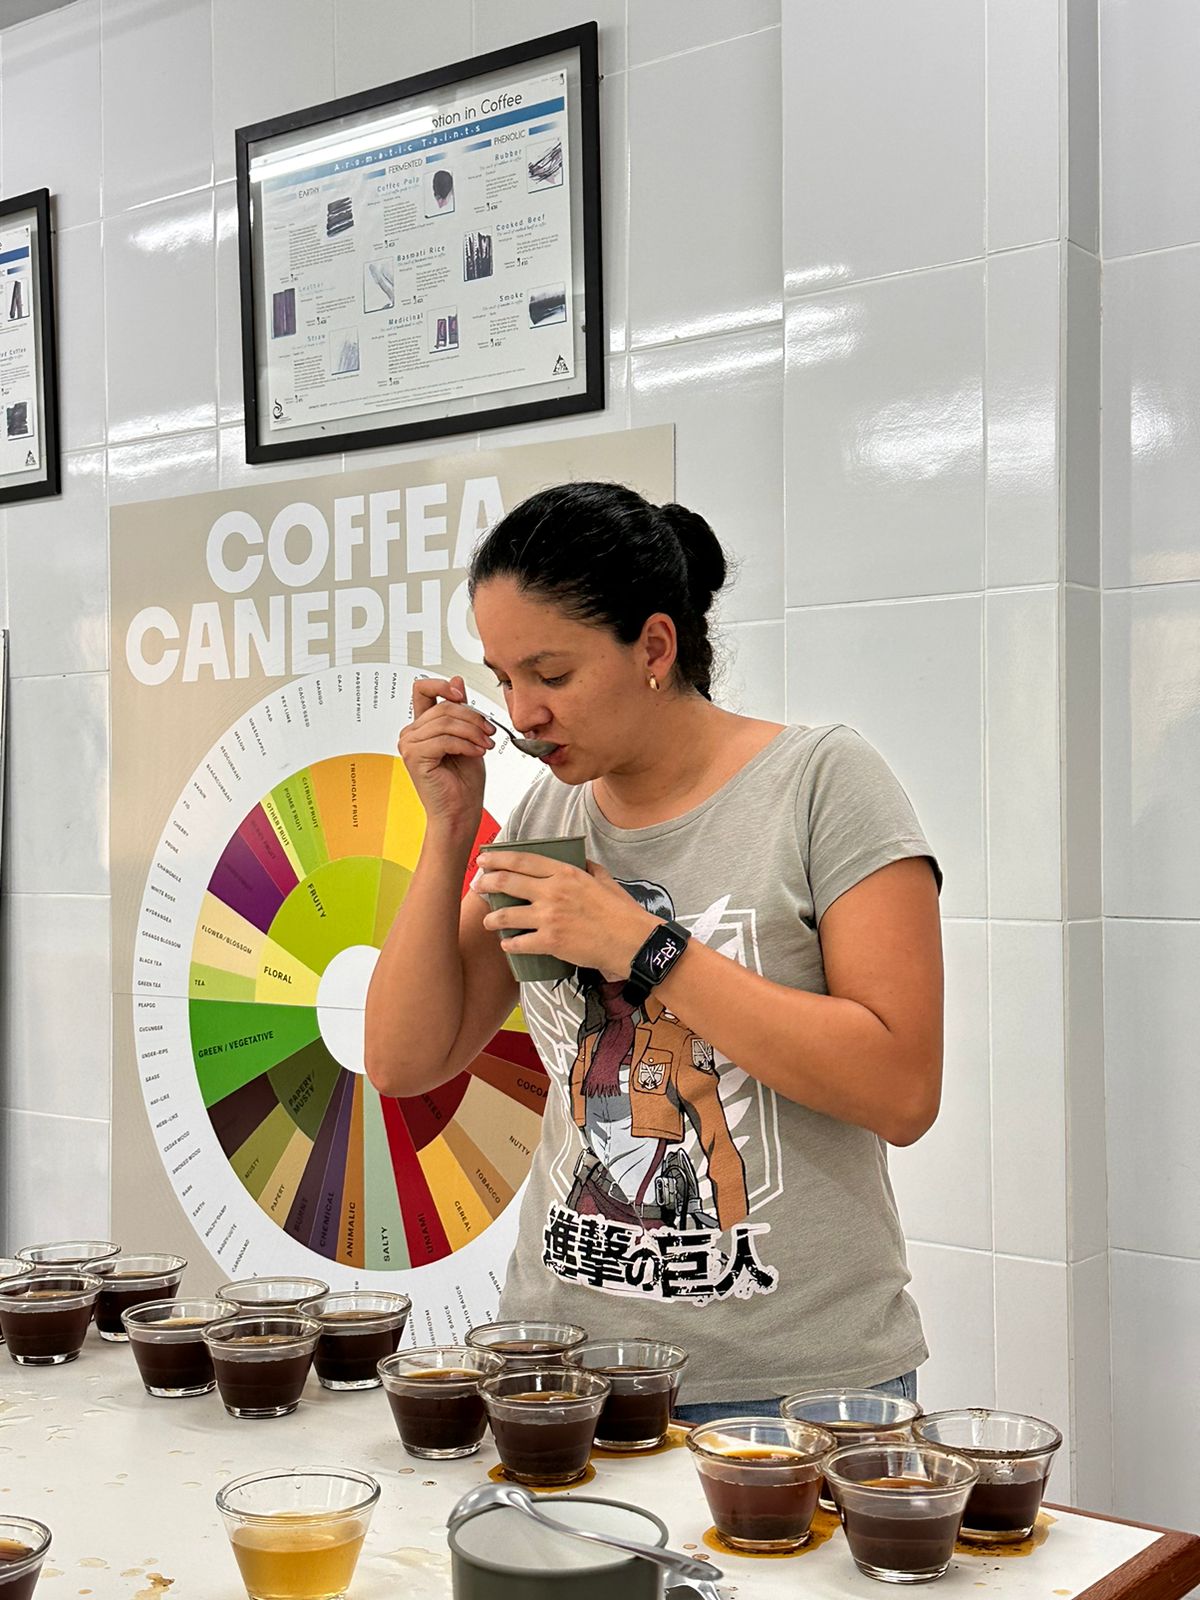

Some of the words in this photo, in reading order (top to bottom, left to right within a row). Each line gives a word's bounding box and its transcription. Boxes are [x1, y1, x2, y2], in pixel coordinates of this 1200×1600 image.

[464, 107, 477, 120] in
[480, 94, 523, 115] Coffee
[493, 129, 526, 146] PHENOLIC
[388, 158, 422, 174] FERMENTED
[495, 149, 521, 161] Rubber
[495, 219, 524, 231] Cooked
[527, 213, 545, 224] Beef
[397, 249, 426, 262] Basmati
[499, 292, 524, 302] Smoke
[388, 312, 424, 325] Medicinal
[206, 475, 505, 594] COFFEA
[315, 679, 323, 705] MANGO
[265, 705, 273, 722] PEAR
[284, 707, 292, 723] LIME
[298, 686, 306, 709] CACAO
[302, 709, 310, 728] SEED
[234, 730, 246, 751] MELON
[248, 717, 259, 738] GREEN
[257, 737, 267, 757] APPLE
[284, 787, 295, 810] POME
[292, 809, 303, 831] FRUIT
[302, 776, 313, 805] CITRUS
[308, 805, 319, 828] FRUIT
[266, 802, 280, 828] OTHER
[277, 824, 290, 846] FRUIT
[164, 839, 179, 854] PRUNE
[151, 884, 165, 897] WHITE
[164, 890, 176, 903] ROSE
[307, 882, 327, 918] FRUITY
[145, 907, 172, 924] HYDRANGEA
[141, 930, 160, 942] ORANGE
[160, 936, 182, 949] BLOSSOM
[139, 956, 153, 965] BLACK
[153, 959, 162, 967] TEA
[263, 965, 293, 985] FLORAL
[139, 1024, 163, 1033] CUCUMBER
[198, 1044, 223, 1058] GREEN
[229, 1030, 274, 1050] VEGETATIVE
[145, 1073, 160, 1083] GRASS
[516, 1077, 548, 1098] COCOA
[293, 1085, 314, 1114] MUSTY
[163, 1140, 178, 1153] CEDAR
[177, 1130, 190, 1142] WOOD
[508, 1135, 531, 1156] NUTTY
[172, 1158, 189, 1175] SMOKED
[188, 1148, 201, 1160] WOOD
[244, 1158, 260, 1179] MUSTY
[270, 1184, 285, 1212] PAPERY
[475, 1168, 501, 1204] TOBACCO
[192, 1201, 206, 1217] EARTH
[294, 1196, 309, 1233] BURNT
[320, 1191, 335, 1248] CHEMICAL
[454, 1200, 472, 1233] CEREAL
[346, 1201, 356, 1258] ANIMALIC
[417, 1213, 433, 1254] UMAMI
[381, 1226, 390, 1262] SALTY
[488, 1270, 502, 1296] BASMA
[455, 1285, 467, 1310] SAUCE
[424, 1309, 436, 1347] USHROOM
[444, 1304, 455, 1329] SAUCE
